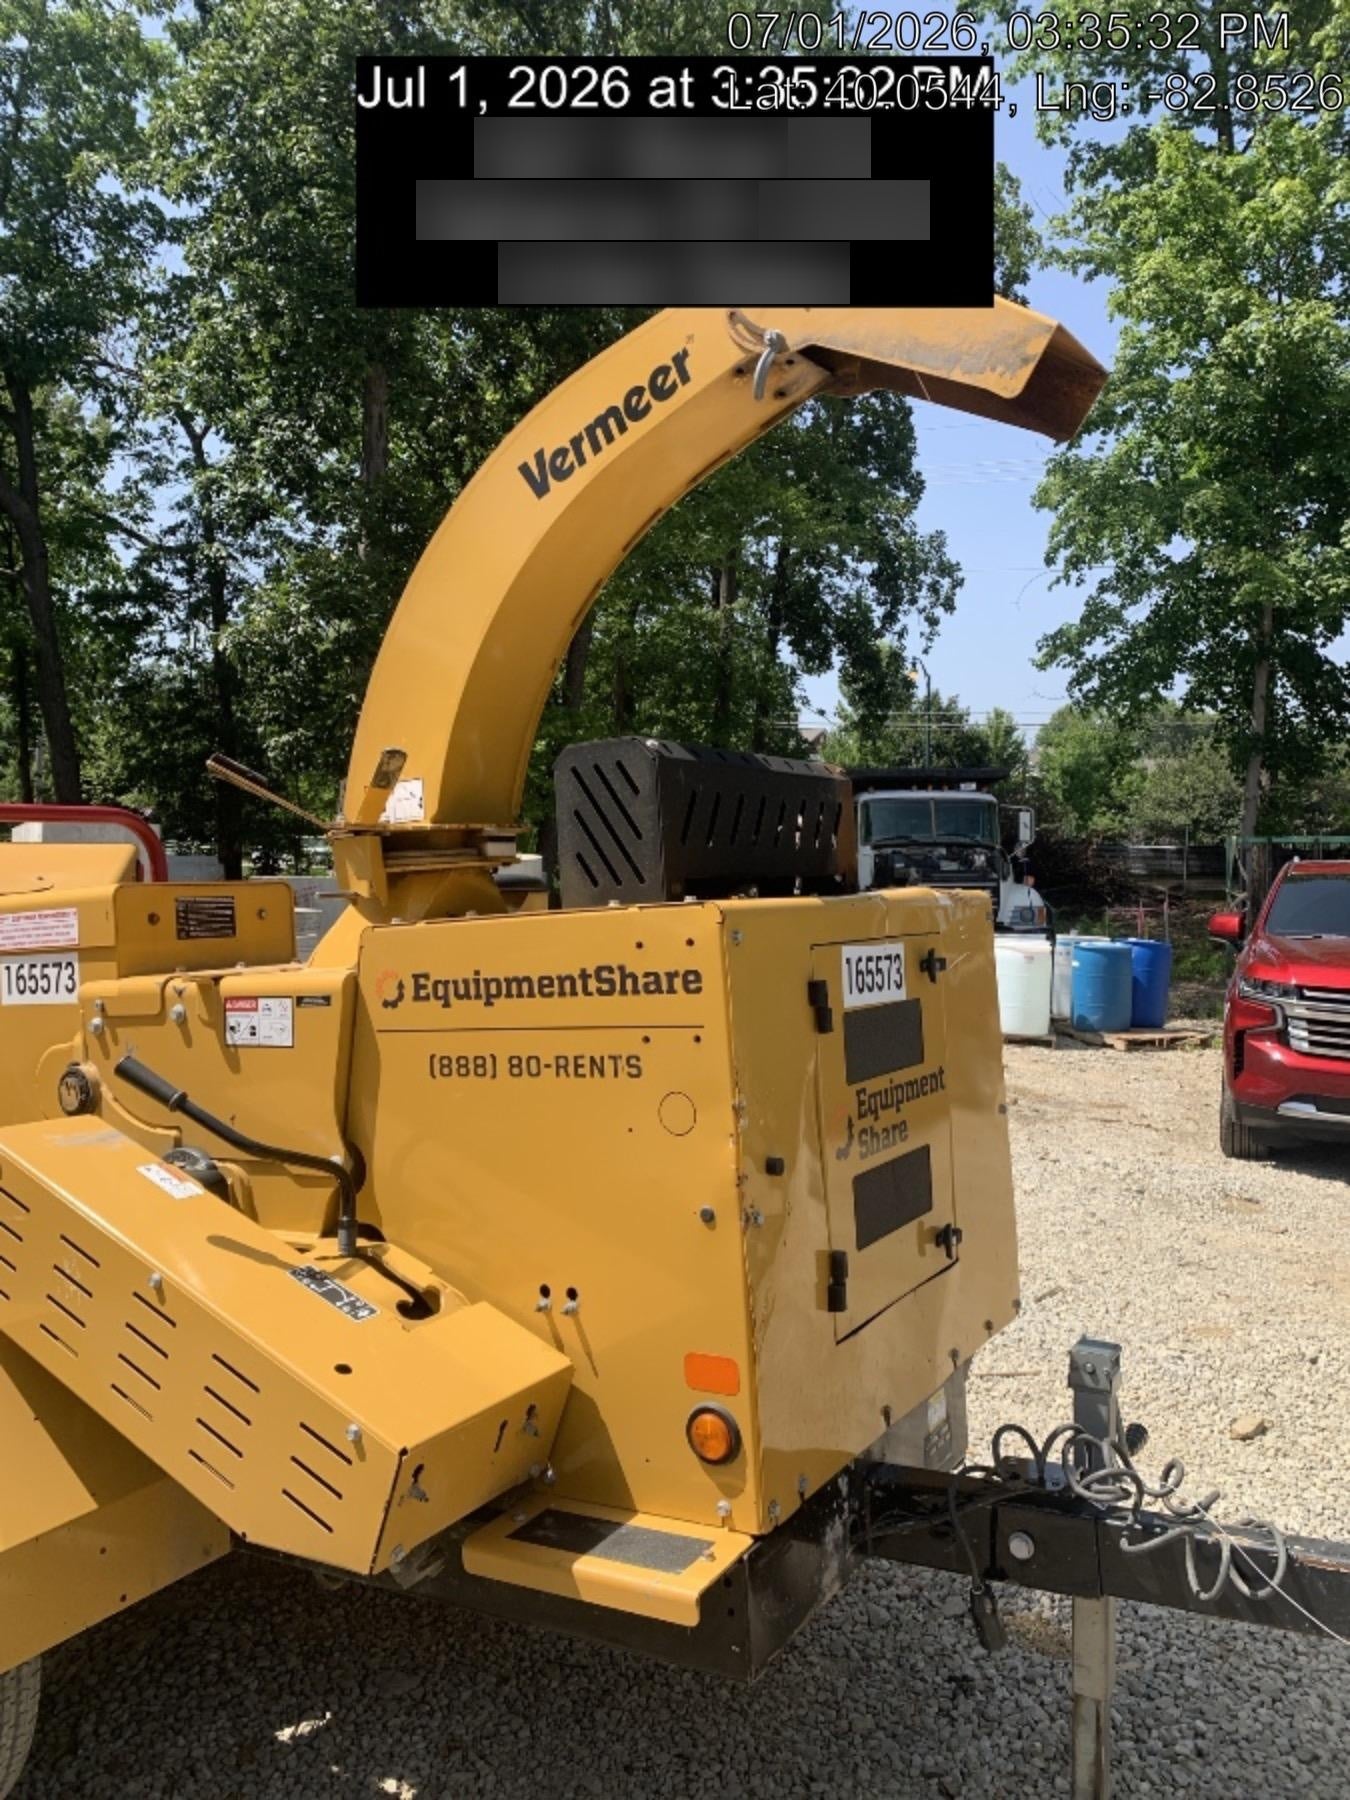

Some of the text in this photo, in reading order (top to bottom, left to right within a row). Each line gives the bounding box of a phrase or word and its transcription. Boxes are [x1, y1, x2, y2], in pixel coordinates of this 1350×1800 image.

[517, 346, 692, 500] Vermeer
[4, 961, 77, 996] 165573
[411, 964, 703, 1009] EquipmentShare
[845, 953, 903, 995] 165573
[429, 1053, 643, 1079] (888) 80-RENTS
[855, 1065, 946, 1122] Equipment
[857, 1118, 909, 1161] Share
